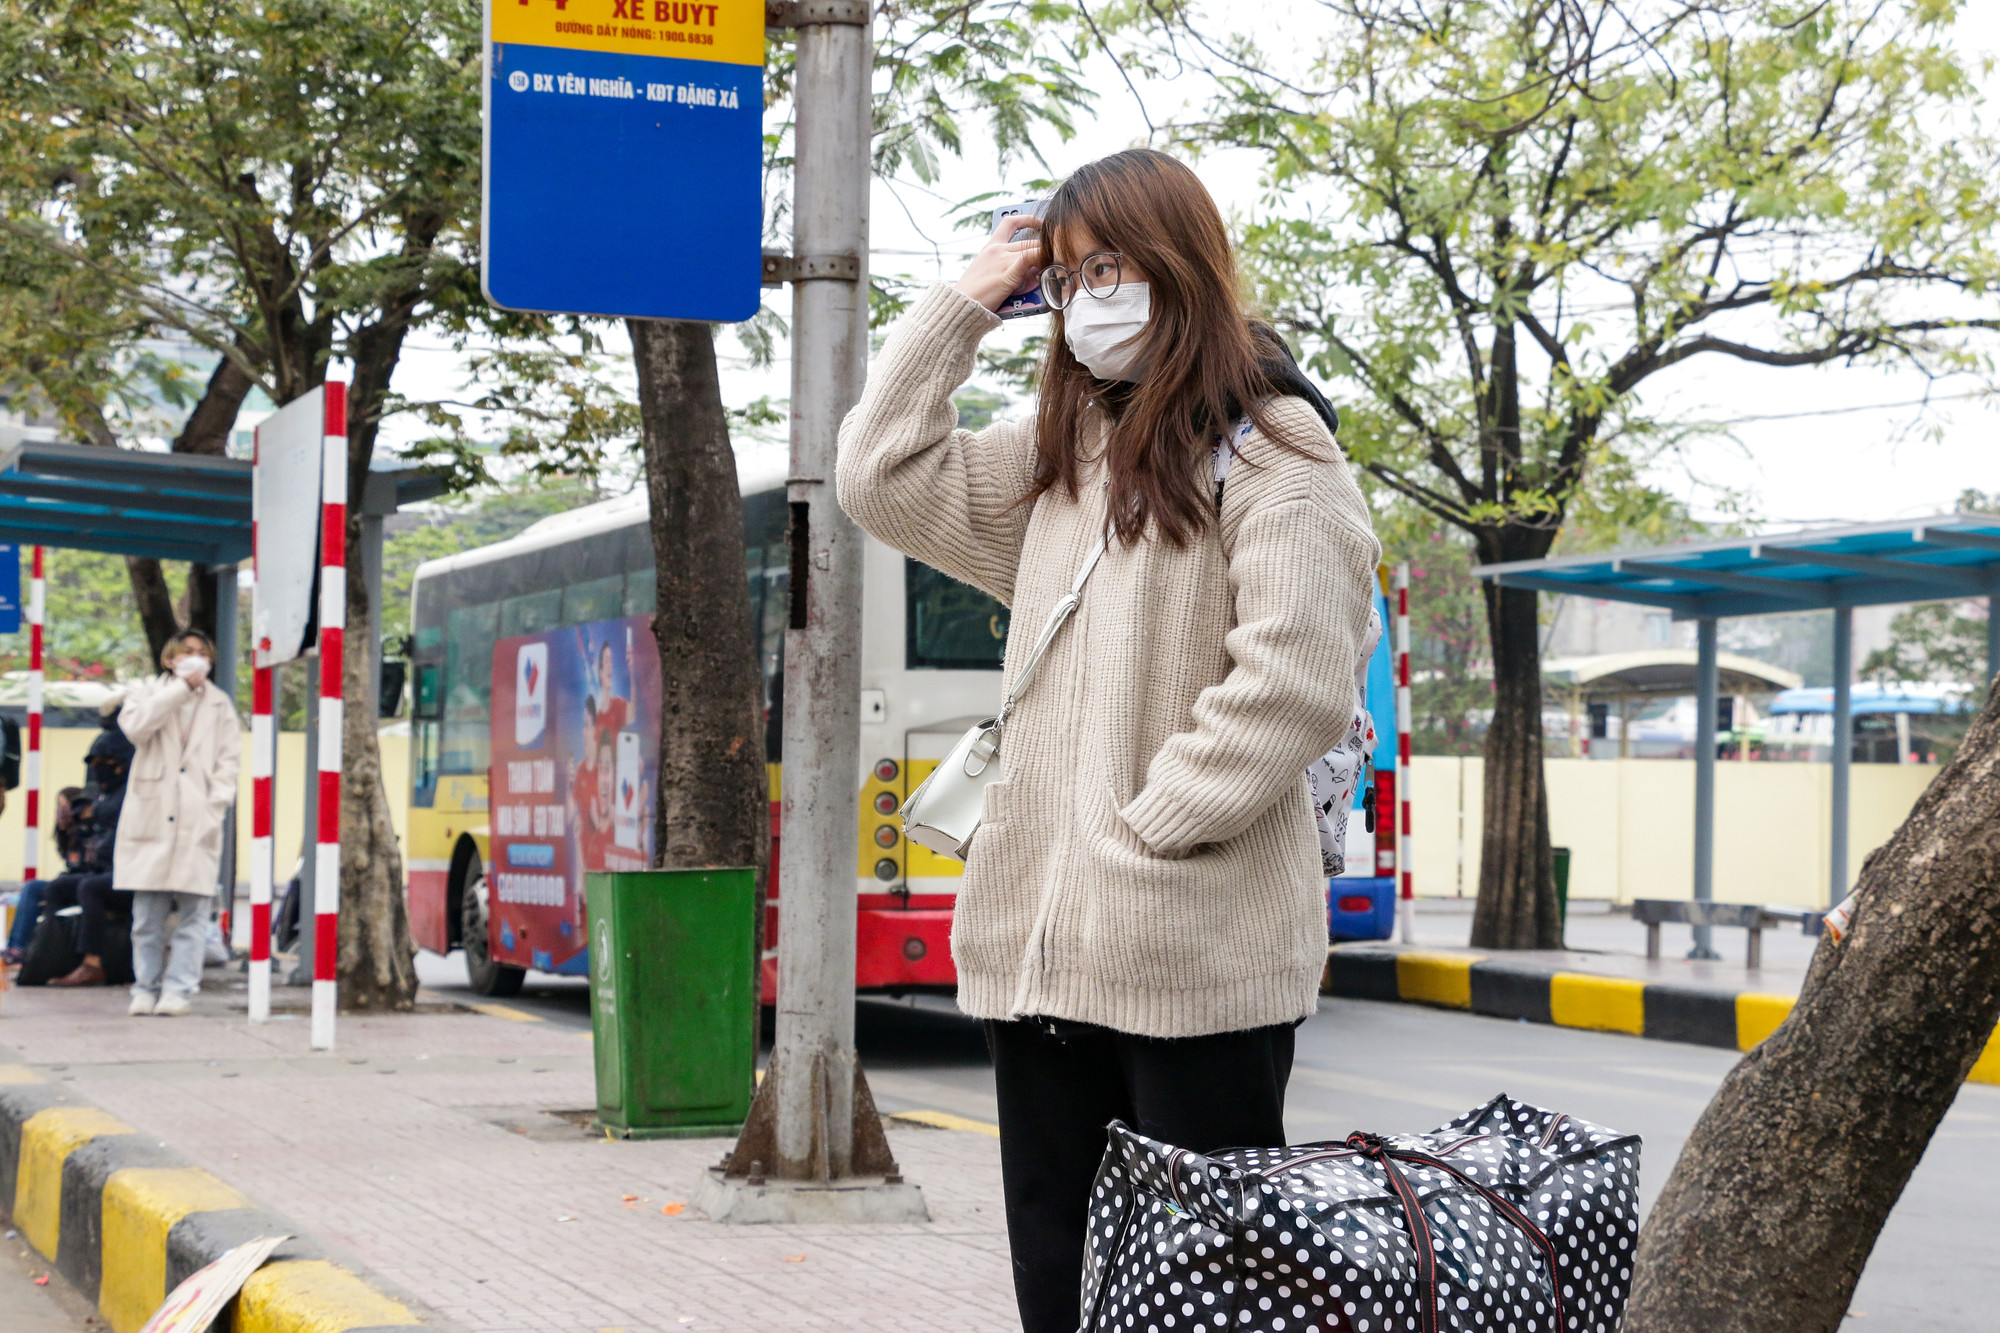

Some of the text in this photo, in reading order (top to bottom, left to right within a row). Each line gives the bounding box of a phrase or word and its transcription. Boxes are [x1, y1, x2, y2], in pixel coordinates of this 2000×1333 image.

[533, 73, 554, 93] BX
[557, 72, 586, 96] YÊN
[589, 76, 634, 99] NGHĨA
[646, 83, 675, 103] KĐT
[677, 82, 717, 110] ĐẶNG
